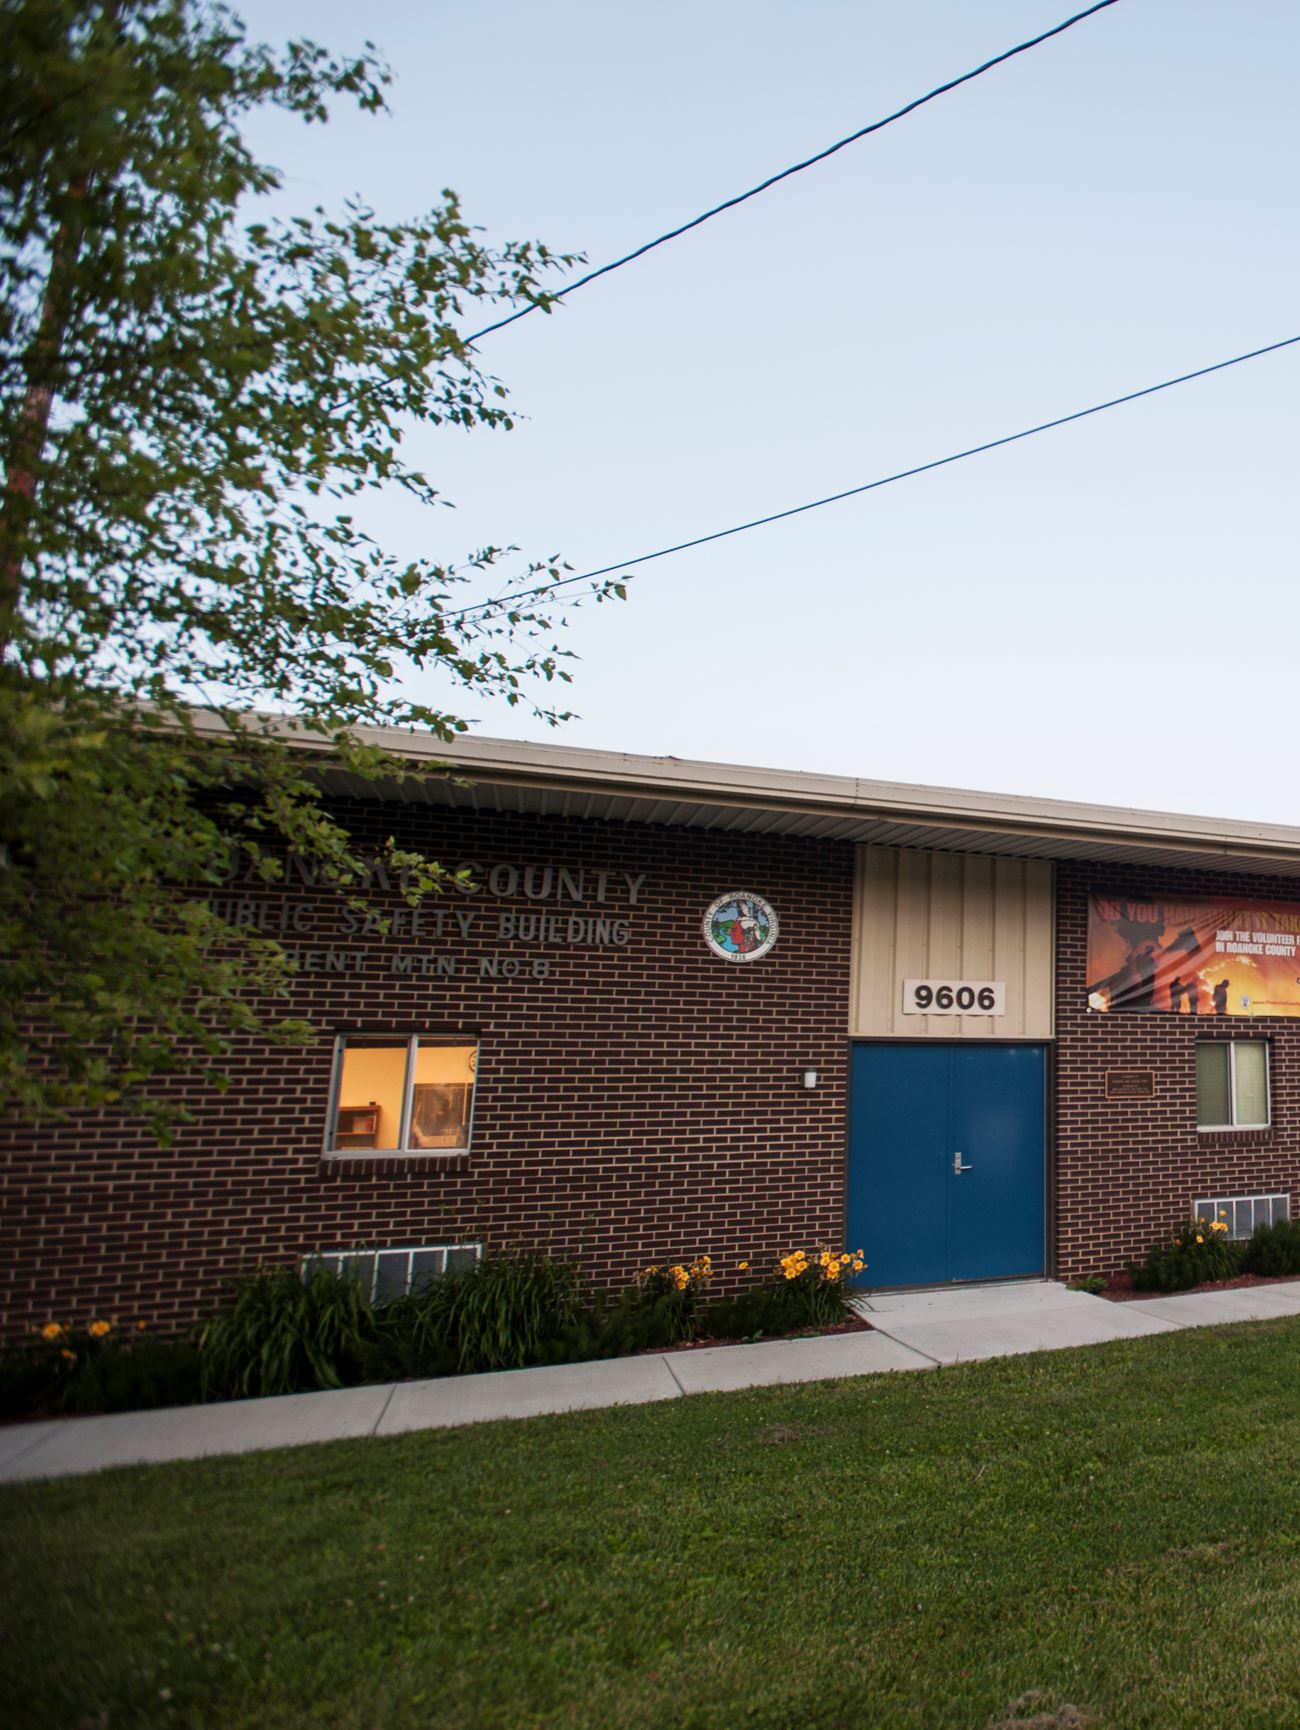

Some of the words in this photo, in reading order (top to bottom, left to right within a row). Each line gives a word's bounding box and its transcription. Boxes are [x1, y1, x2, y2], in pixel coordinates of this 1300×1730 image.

[454, 861, 647, 905] COUNTY
[339, 904, 477, 938] SAFETY
[498, 911, 631, 946] BUILDING
[1126, 902, 1159, 924] YOU
[1215, 929, 1234, 942] JOIN
[1235, 930, 1251, 943] THE
[1252, 931, 1295, 945] VOLUNTEER
[1215, 941, 1225, 953] IN
[1226, 942, 1264, 955] ROANOKE
[1265, 944, 1297, 957] COUNTY
[390, 954, 457, 977] MTN
[531, 959, 551, 980] 8
[914, 984, 996, 1011] 9606
